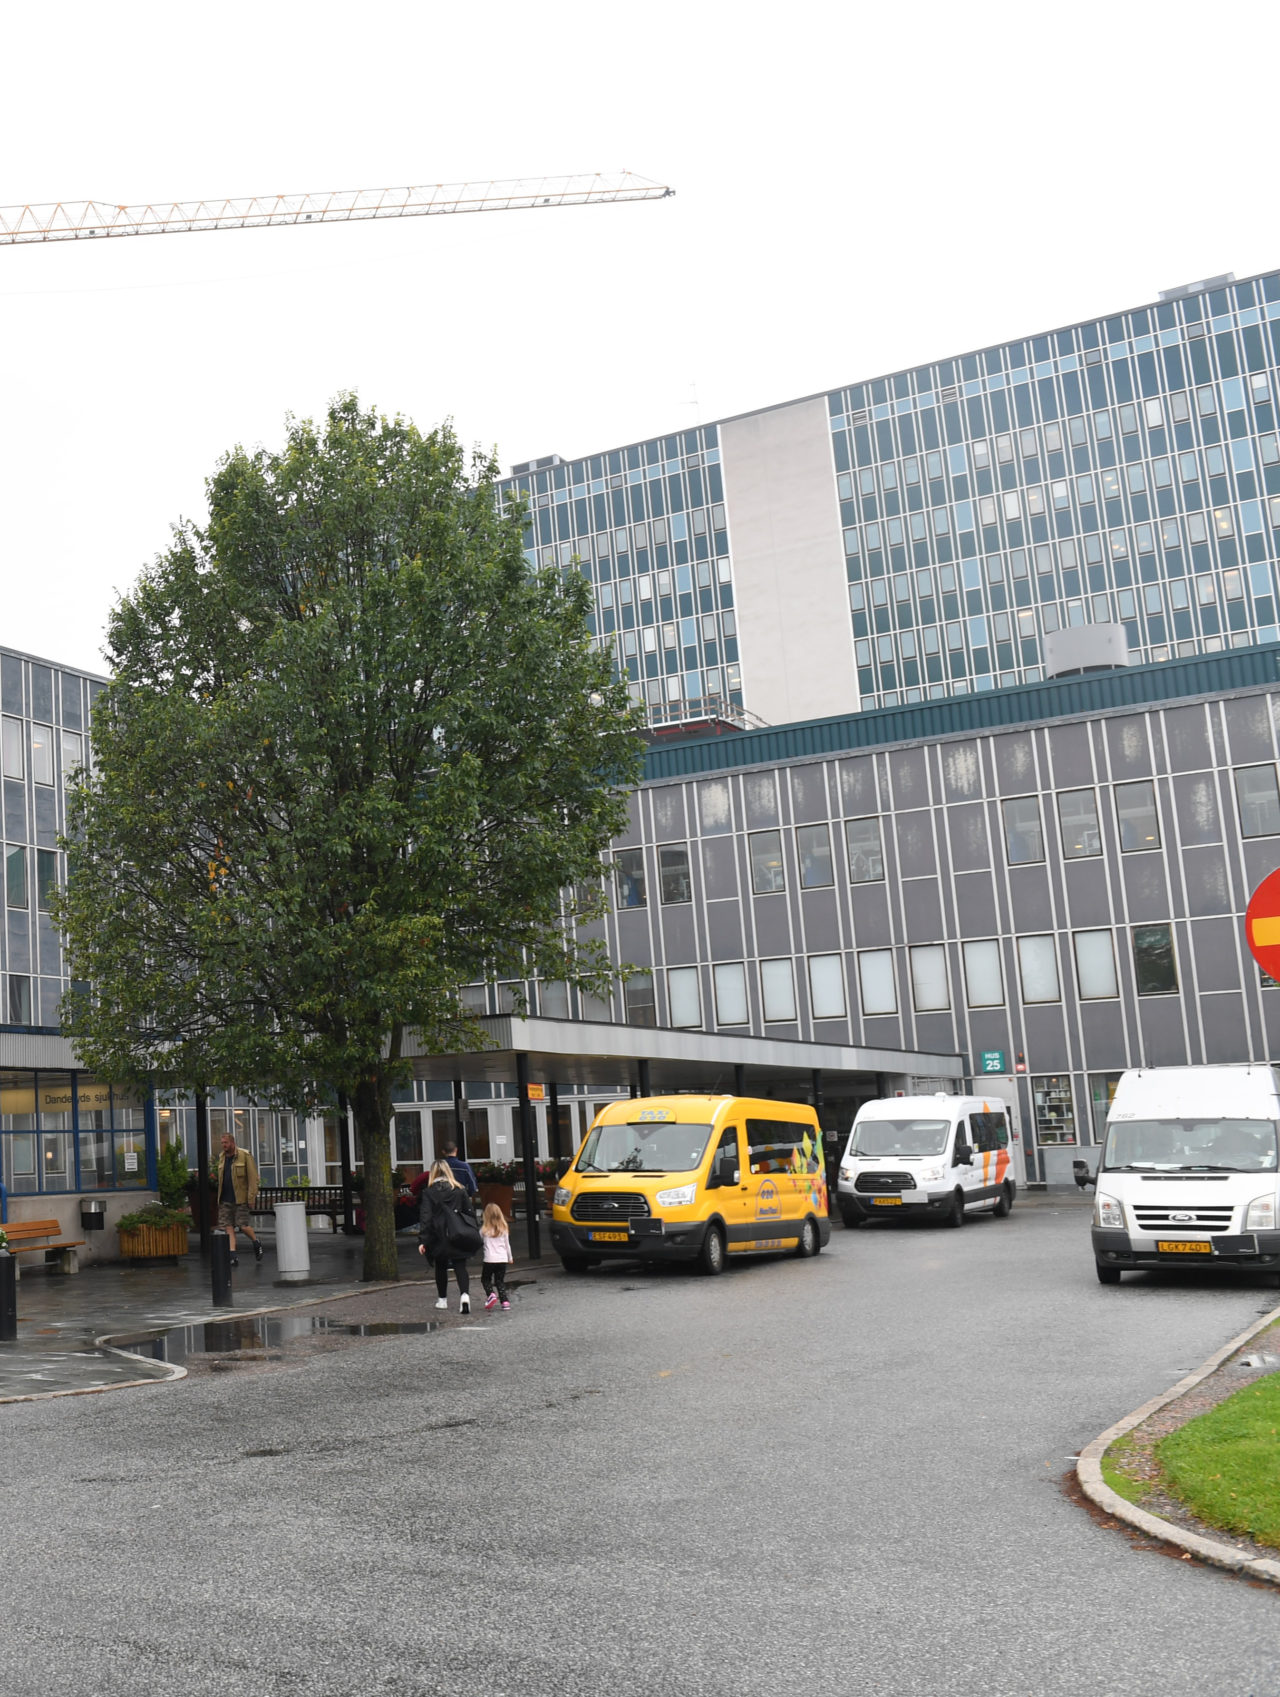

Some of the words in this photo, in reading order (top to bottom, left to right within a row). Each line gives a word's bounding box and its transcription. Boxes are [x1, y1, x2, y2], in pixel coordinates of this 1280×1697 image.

[986, 1060, 1001, 1070] 25
[45, 1093, 91, 1105] Dandeyds
[1161, 1243, 1201, 1252] LGK740
